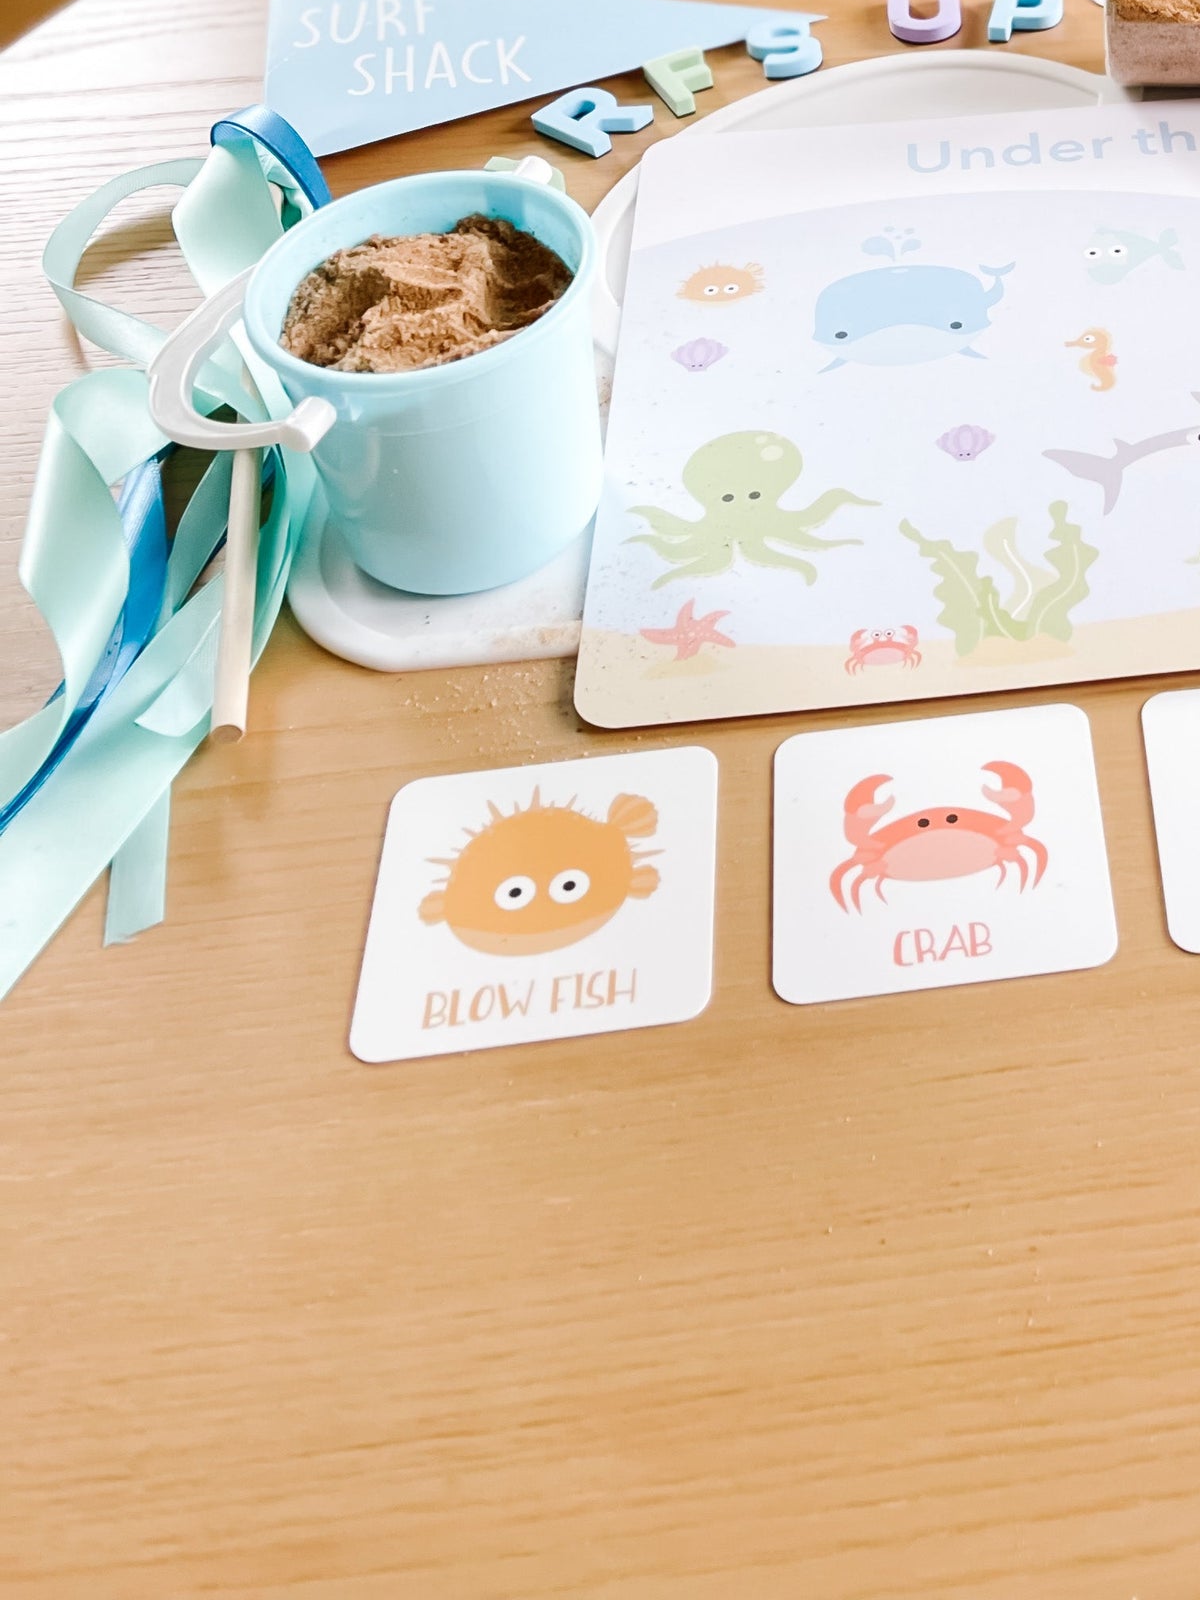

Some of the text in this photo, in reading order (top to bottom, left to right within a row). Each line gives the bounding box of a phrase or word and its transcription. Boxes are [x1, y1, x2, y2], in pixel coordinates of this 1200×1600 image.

[347, 35, 533, 97] SHACK
[906, 131, 1113, 174] Under
[893, 922, 993, 967] CRAB
[421, 968, 638, 1030] BLOW FISH
